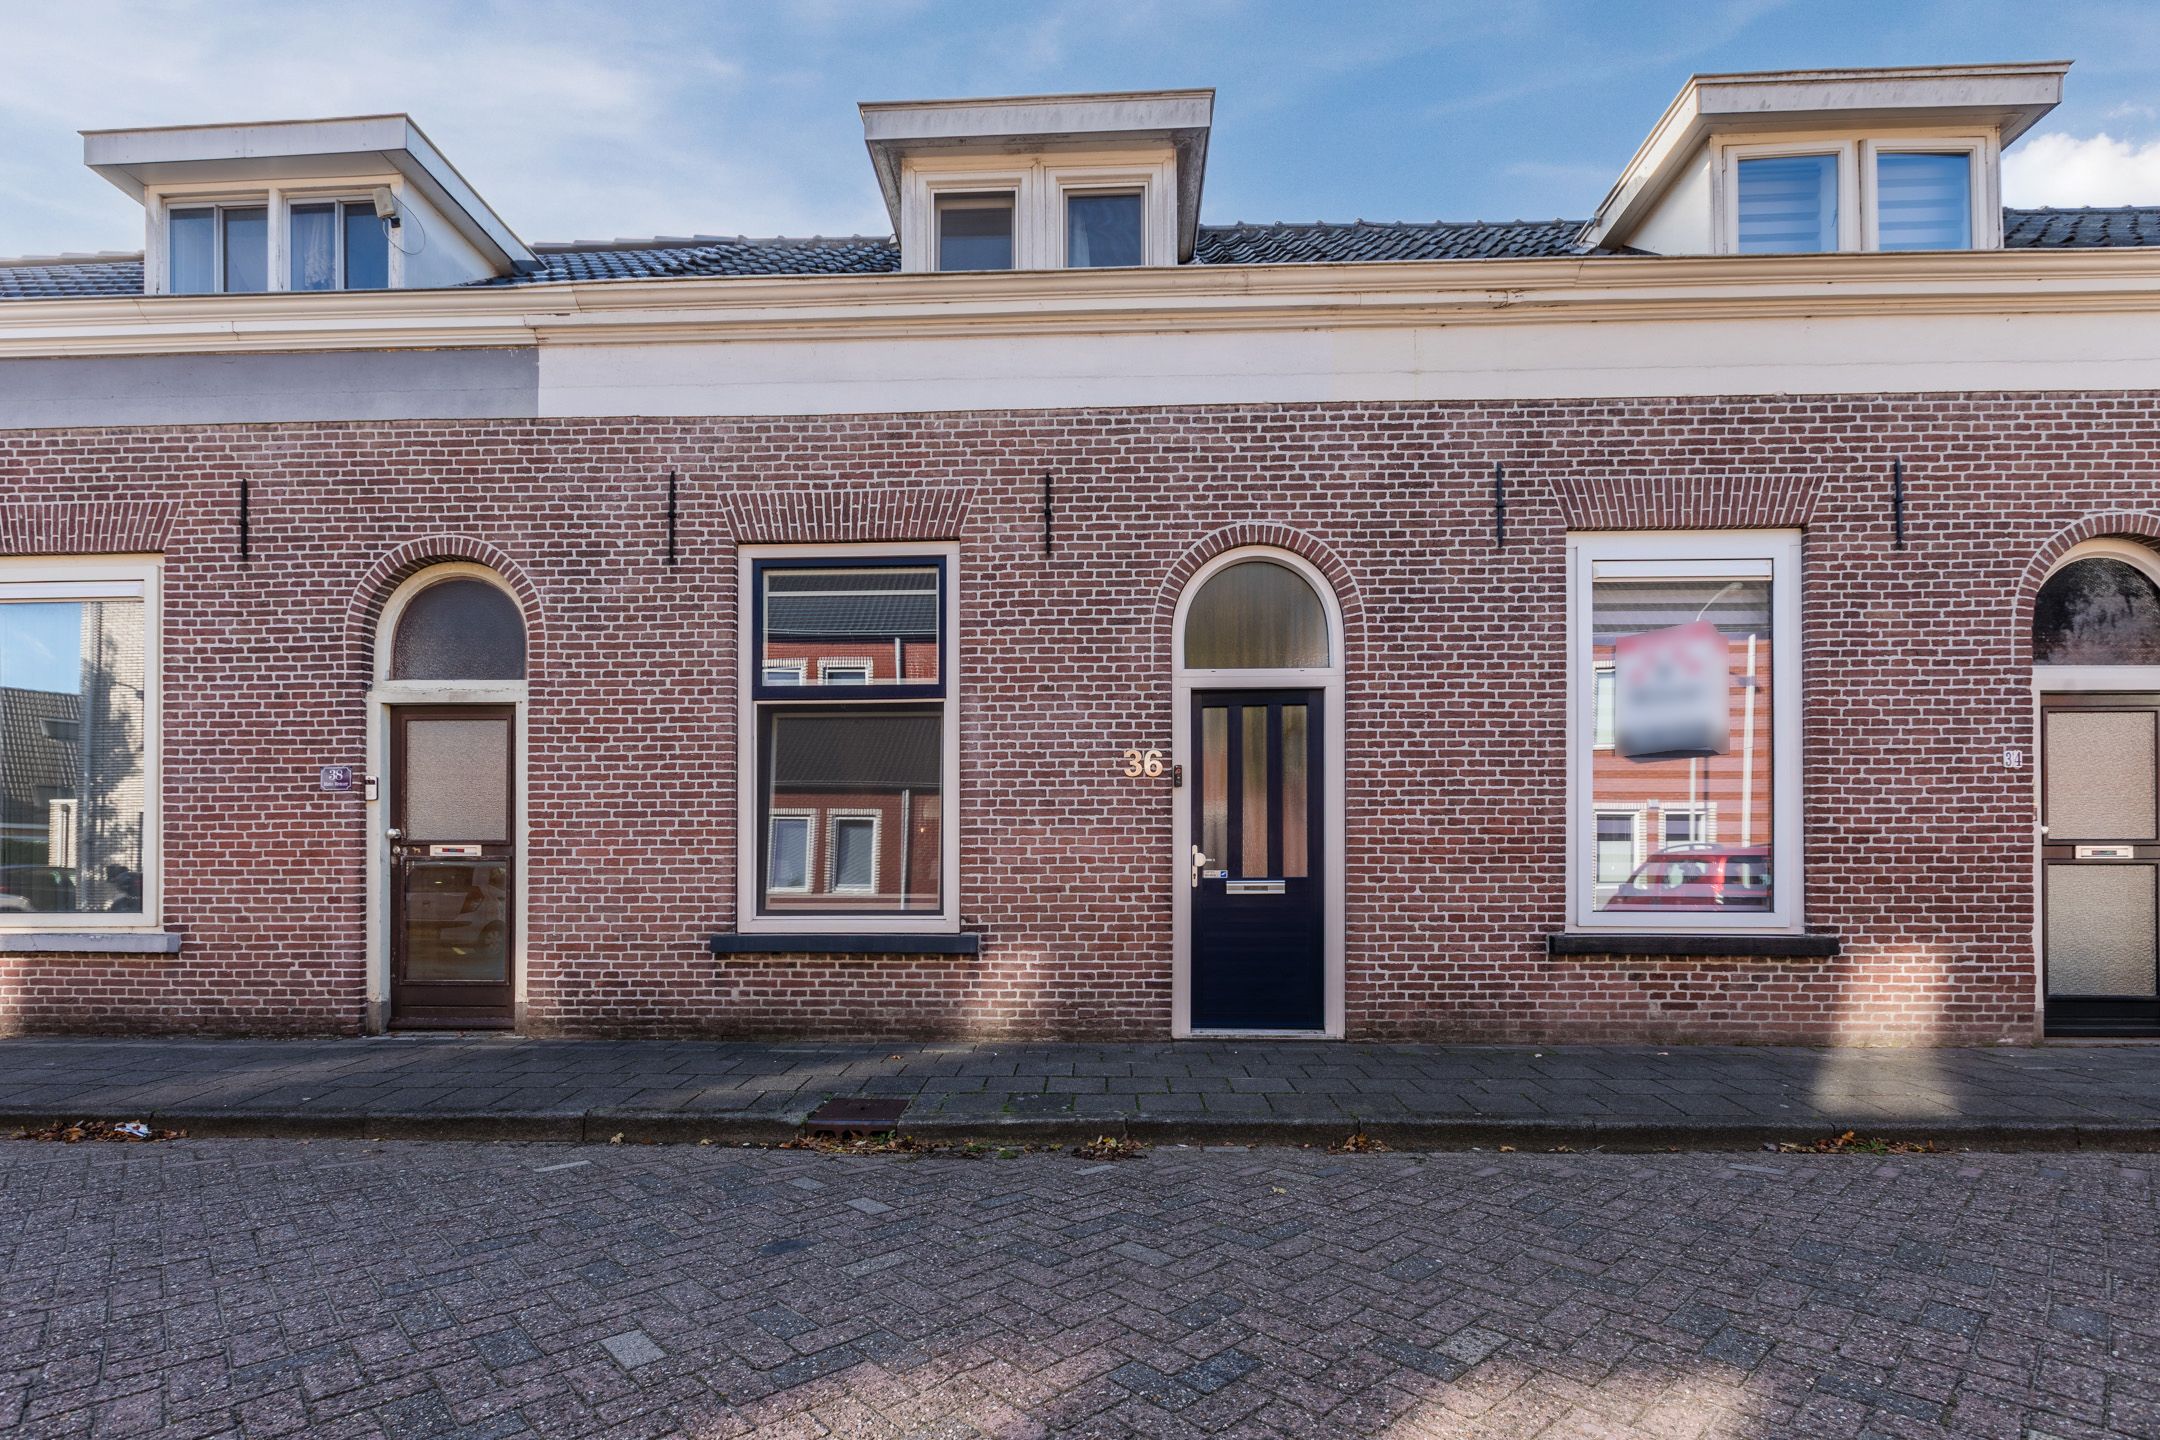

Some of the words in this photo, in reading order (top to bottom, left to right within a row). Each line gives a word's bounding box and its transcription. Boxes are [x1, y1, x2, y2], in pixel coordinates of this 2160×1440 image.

[1124, 750, 1163, 777] 36
[2005, 752, 2022, 767] 34
[328, 769, 343, 781] 38
